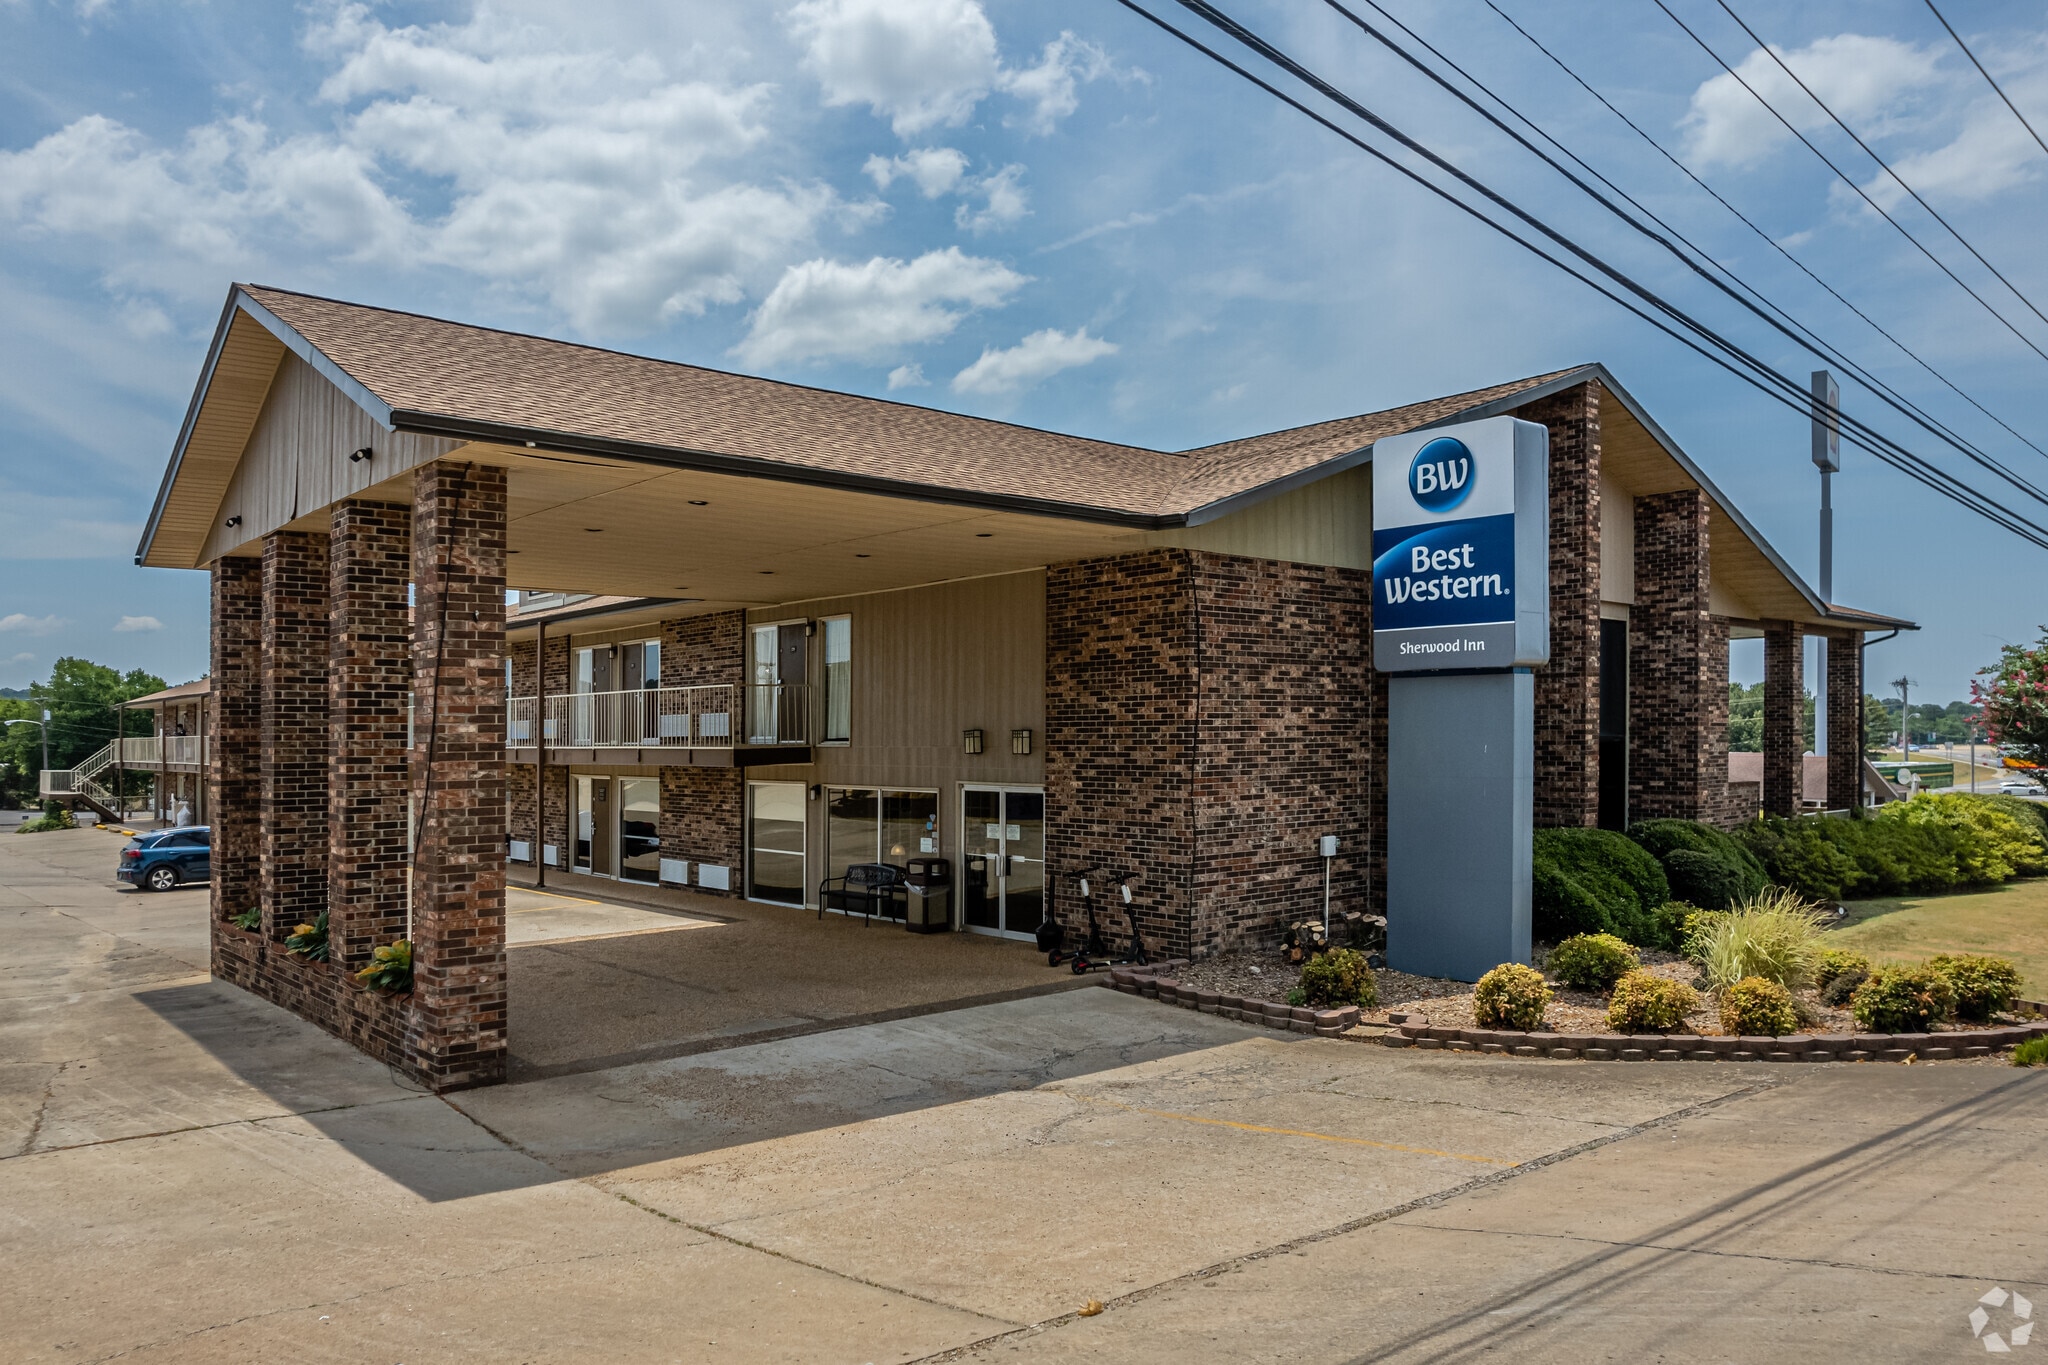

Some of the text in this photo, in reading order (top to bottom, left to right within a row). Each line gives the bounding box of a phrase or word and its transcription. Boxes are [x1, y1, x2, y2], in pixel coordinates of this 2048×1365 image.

[1416, 457, 1468, 494] BW
[1411, 543, 1475, 573] Best
[1399, 638, 1486, 655] Sherwood Inn
